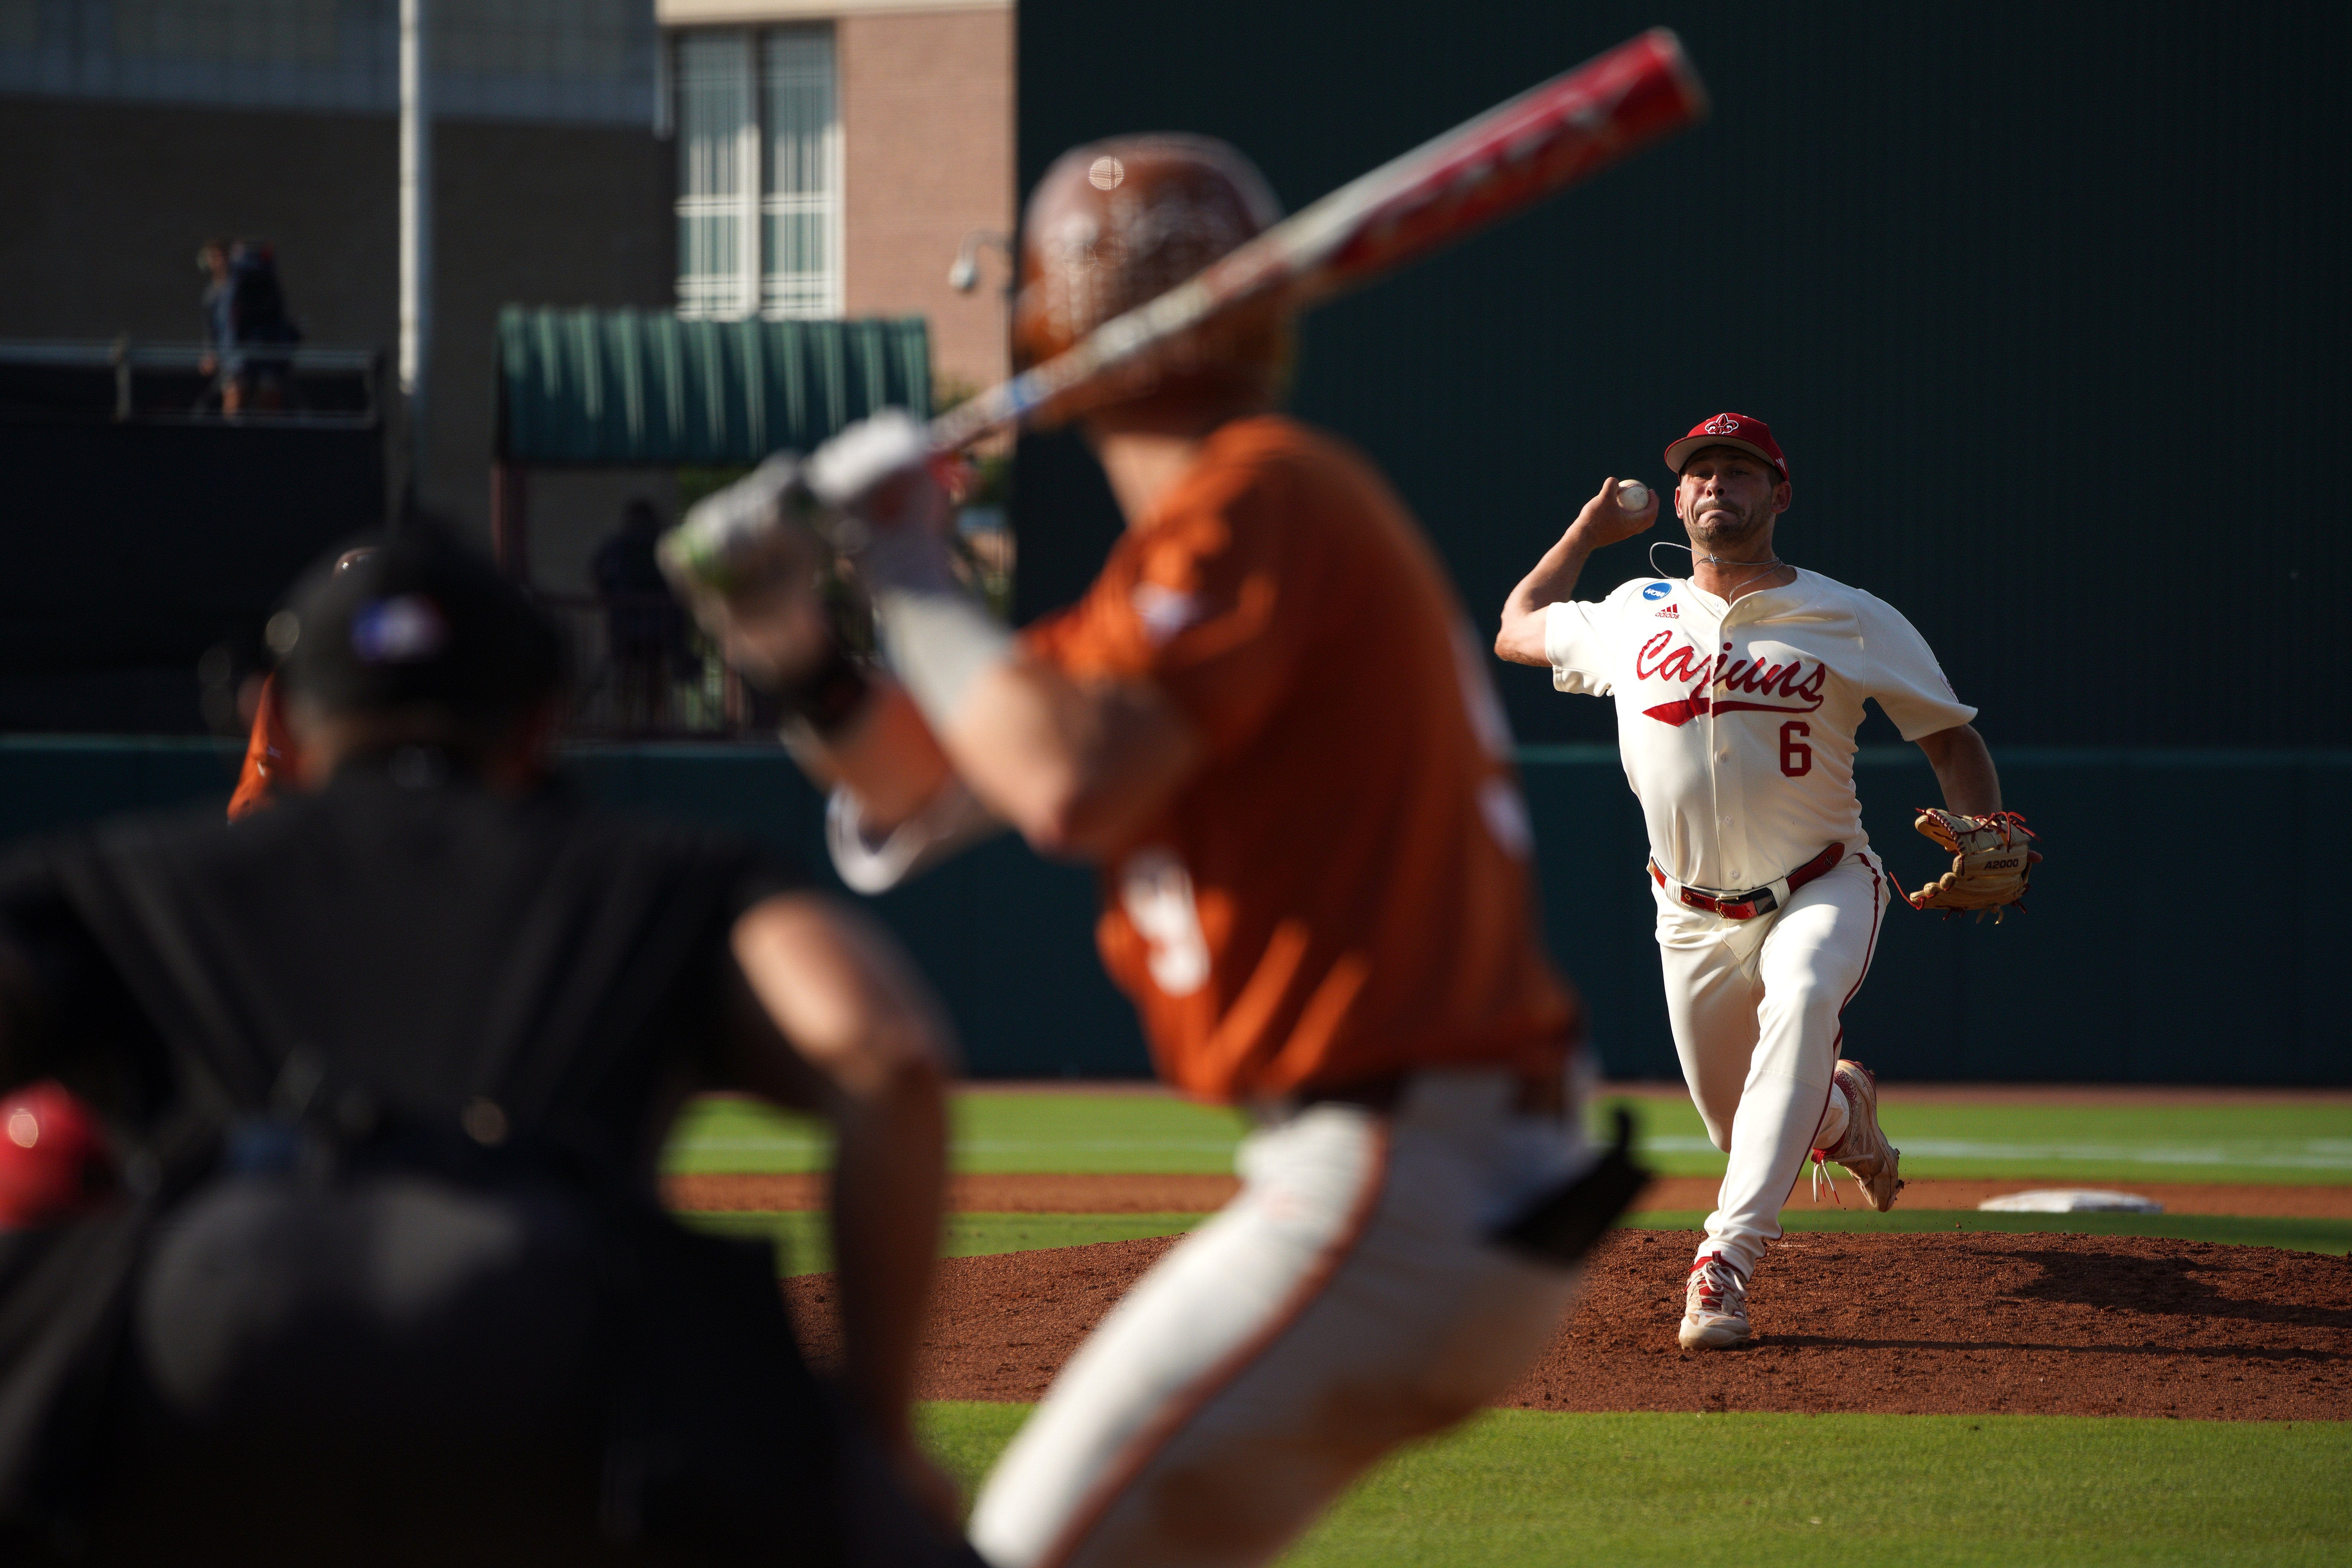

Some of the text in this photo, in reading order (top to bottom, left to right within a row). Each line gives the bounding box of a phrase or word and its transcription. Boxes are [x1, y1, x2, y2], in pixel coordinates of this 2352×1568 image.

[1644, 588, 1666, 598] NCAA
[1636, 629, 1826, 717] Cajuns
[1780, 721, 1812, 777] 6
[1984, 859, 2018, 870] A2000
